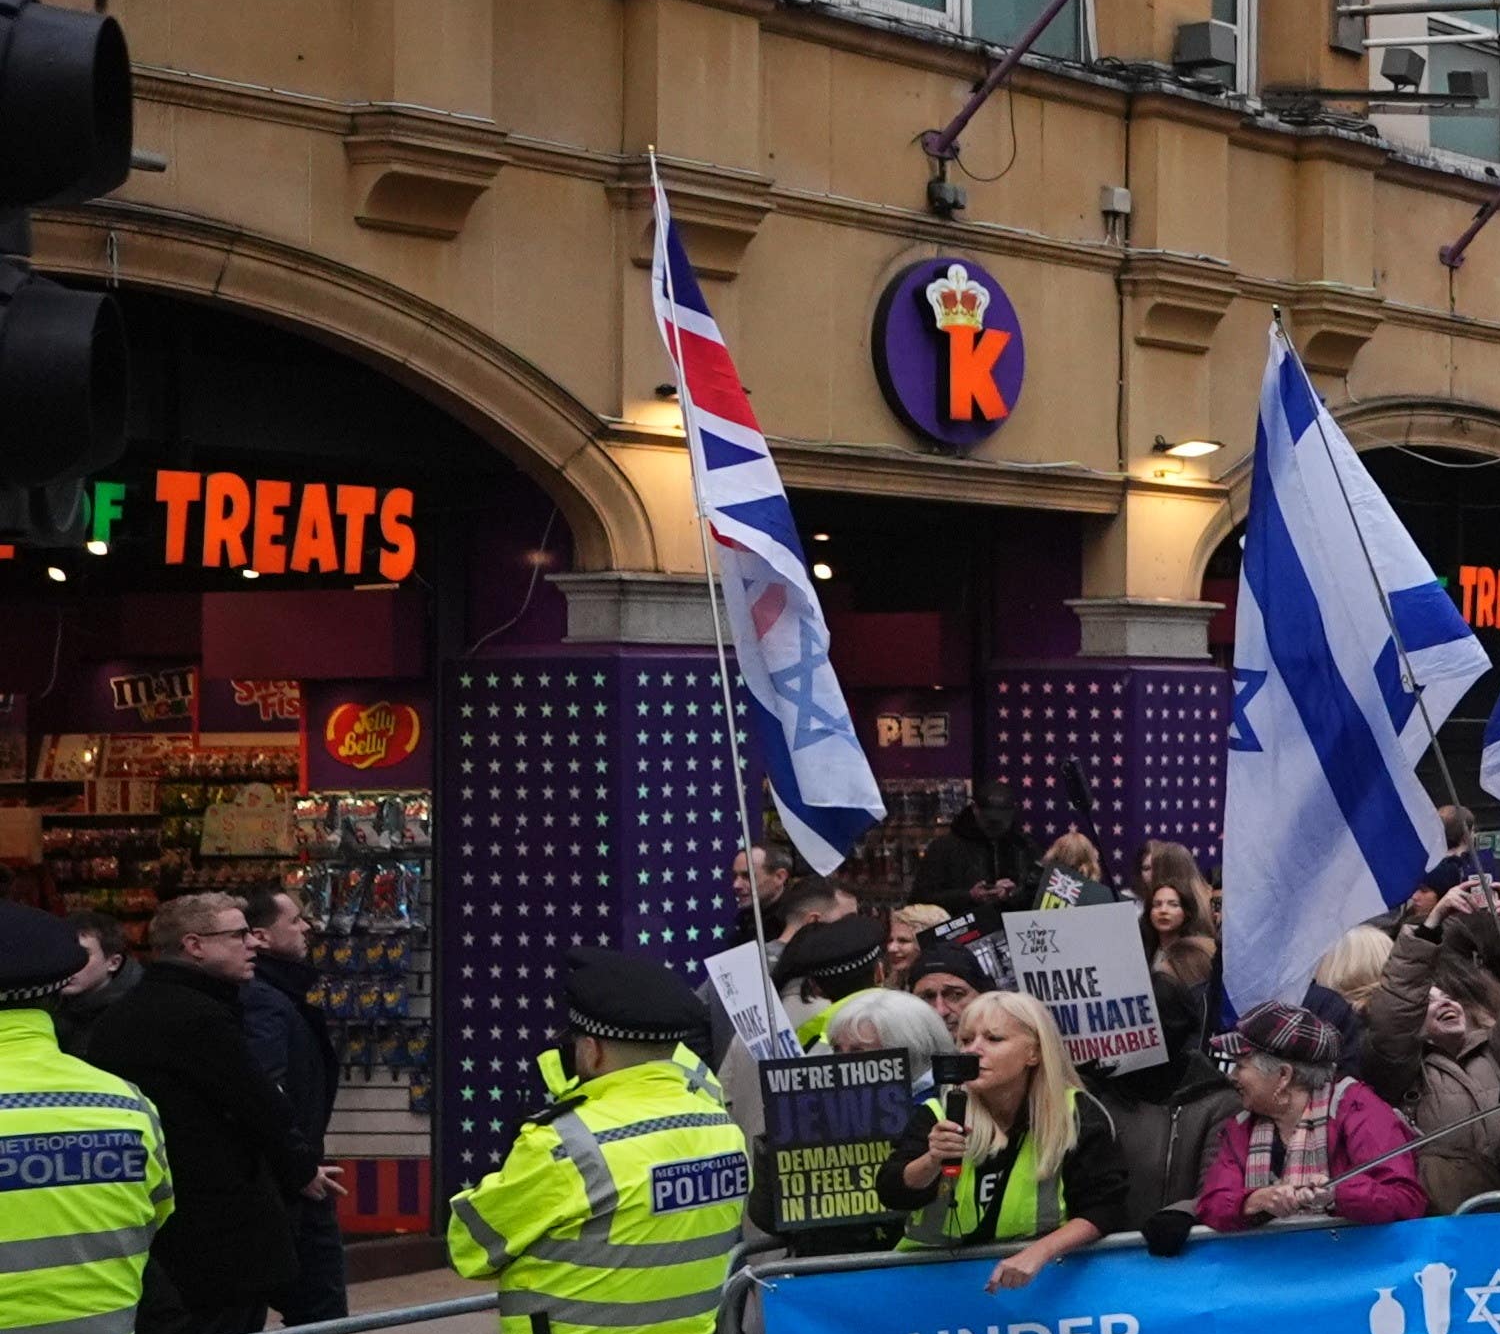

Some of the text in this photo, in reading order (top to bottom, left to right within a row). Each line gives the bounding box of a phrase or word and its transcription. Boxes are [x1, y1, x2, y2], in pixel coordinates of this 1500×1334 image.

[83, 470, 416, 582] F TREATS
[353, 704, 398, 735] Jelly
[338, 729, 388, 759] Belly
[1022, 966, 1102, 1002] MAKE
[1086, 994, 1155, 1033] HATE
[766, 1058, 904, 1094] WE'RE THOSE
[772, 1087, 903, 1147] JEWS
[655, 1154, 745, 1179] METROPOLITAN
[779, 1174, 803, 1198] TO
[808, 1171, 856, 1196] FEEL
[654, 1165, 748, 1211] POLICE
[781, 1191, 887, 1223] IN LONDO
